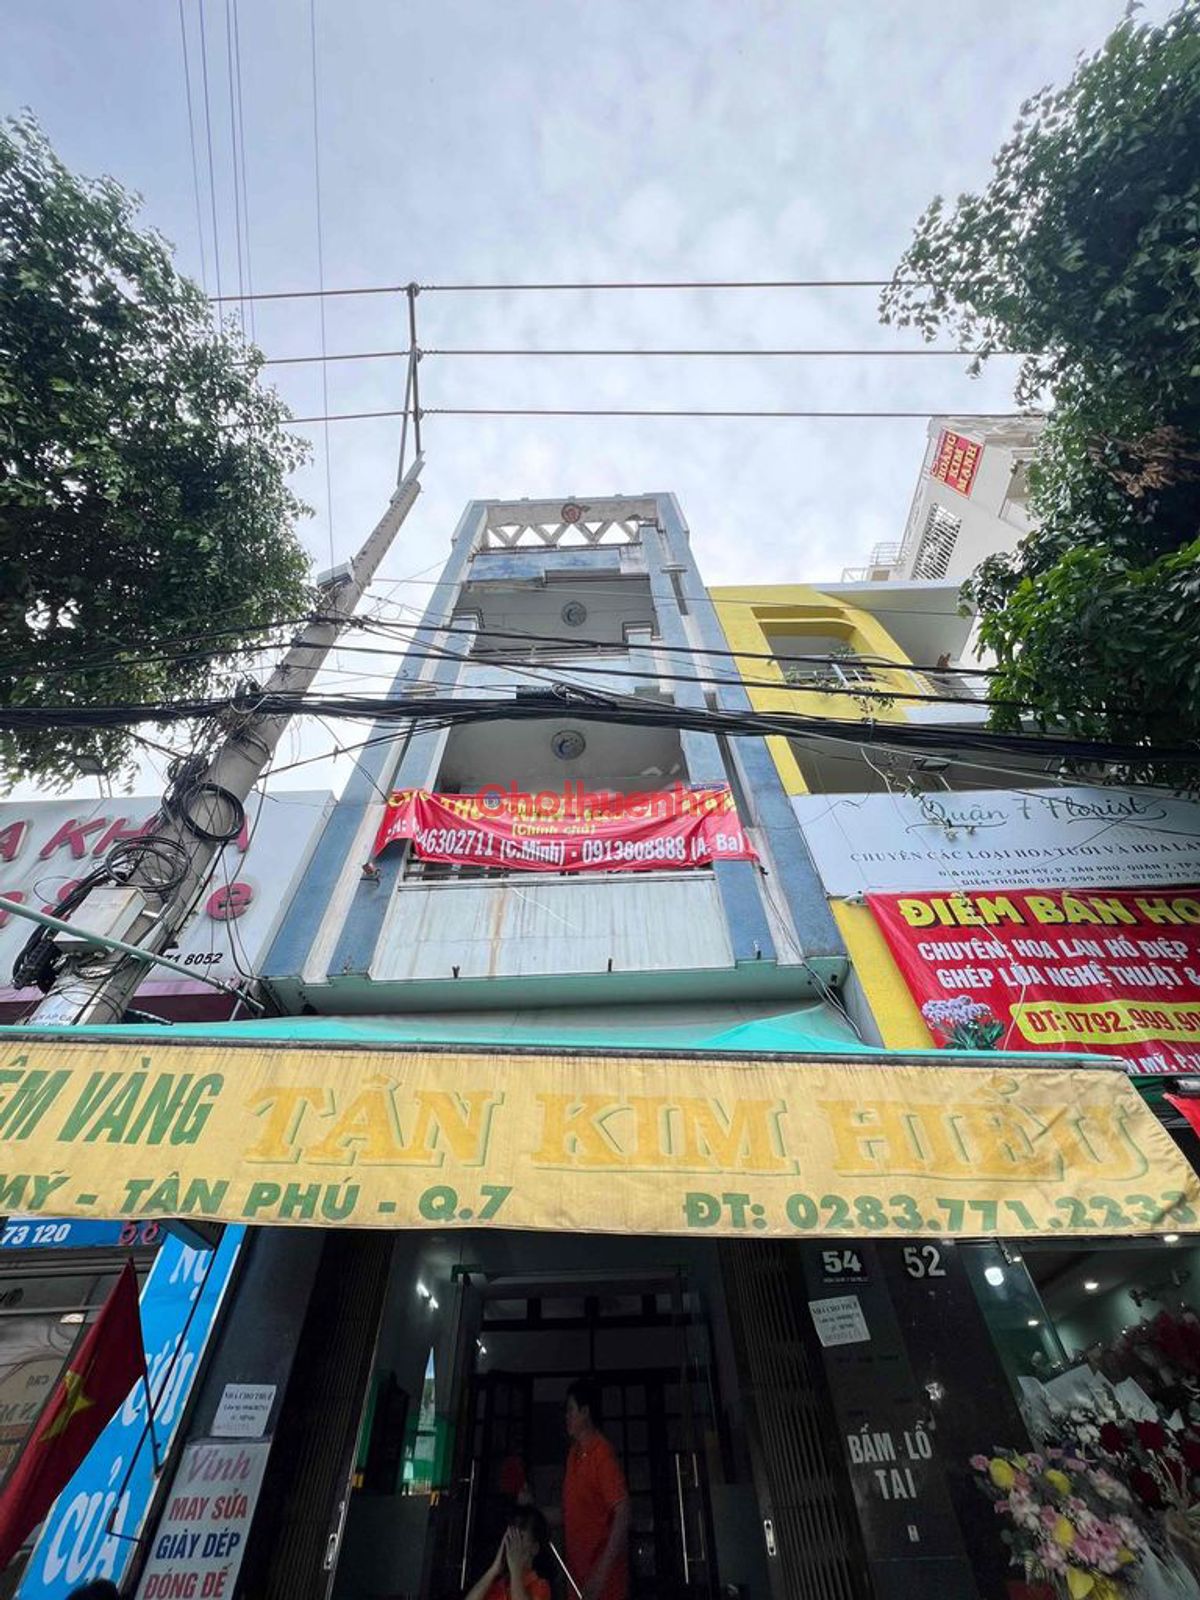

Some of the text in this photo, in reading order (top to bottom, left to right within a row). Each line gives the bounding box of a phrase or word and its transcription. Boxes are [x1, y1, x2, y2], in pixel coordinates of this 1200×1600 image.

[1041, 795, 1156, 821] Florist
[1023, 889, 1138, 926] BÁN
[1011, 938, 1060, 960] HOA
[1057, 938, 1106, 959] LAN
[935, 964, 995, 989] GHÉP
[1044, 960, 1113, 987] NGHỆ
[1106, 962, 1184, 991] THUẬT
[57, 1057, 225, 1146] VÀNG
[530, 1092, 801, 1177] KIM
[119, 1170, 229, 1214] TÂN
[242, 1176, 361, 1220] PHÚ
[418, 1185, 513, 1222] Q.7
[682, 1192, 768, 1230] ĐT:
[785, 1189, 1198, 1232] 0283.771.2233
[31, 1223, 72, 1244] 120
[822, 1250, 862, 1274] 54
[903, 1245, 946, 1279] 52
[847, 1422, 897, 1464] BẤM
[873, 1468, 918, 1500] TAI
[168, 1496, 210, 1522] MAY
[202, 1527, 241, 1560] DÉP
